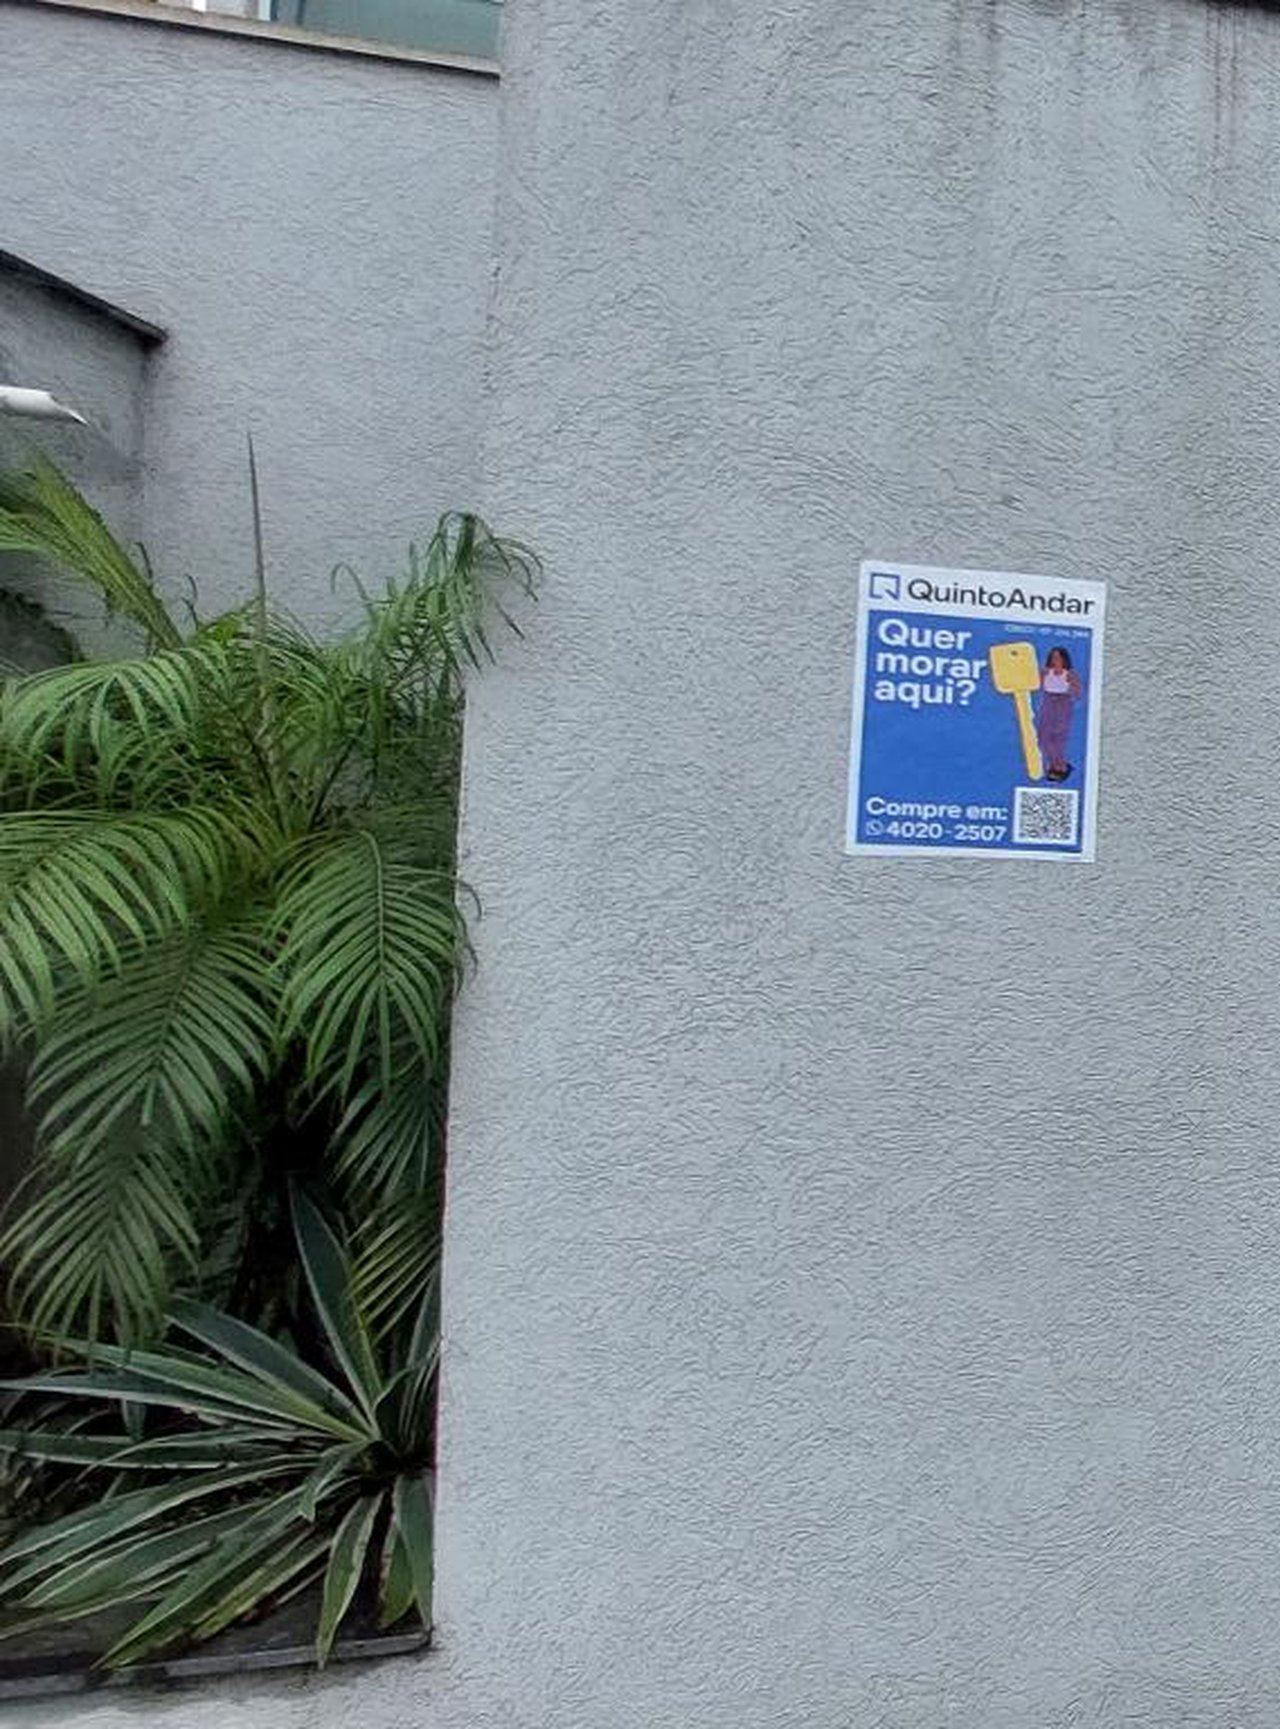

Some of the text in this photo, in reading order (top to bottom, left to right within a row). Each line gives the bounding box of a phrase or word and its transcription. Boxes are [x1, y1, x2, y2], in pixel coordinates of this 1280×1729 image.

[907, 578, 1095, 616] QuintoAndar
[877, 618, 973, 651] Quer
[875, 651, 988, 680] morar
[873, 678, 977, 709] aqui?
[865, 796, 1009, 821] Compre em:
